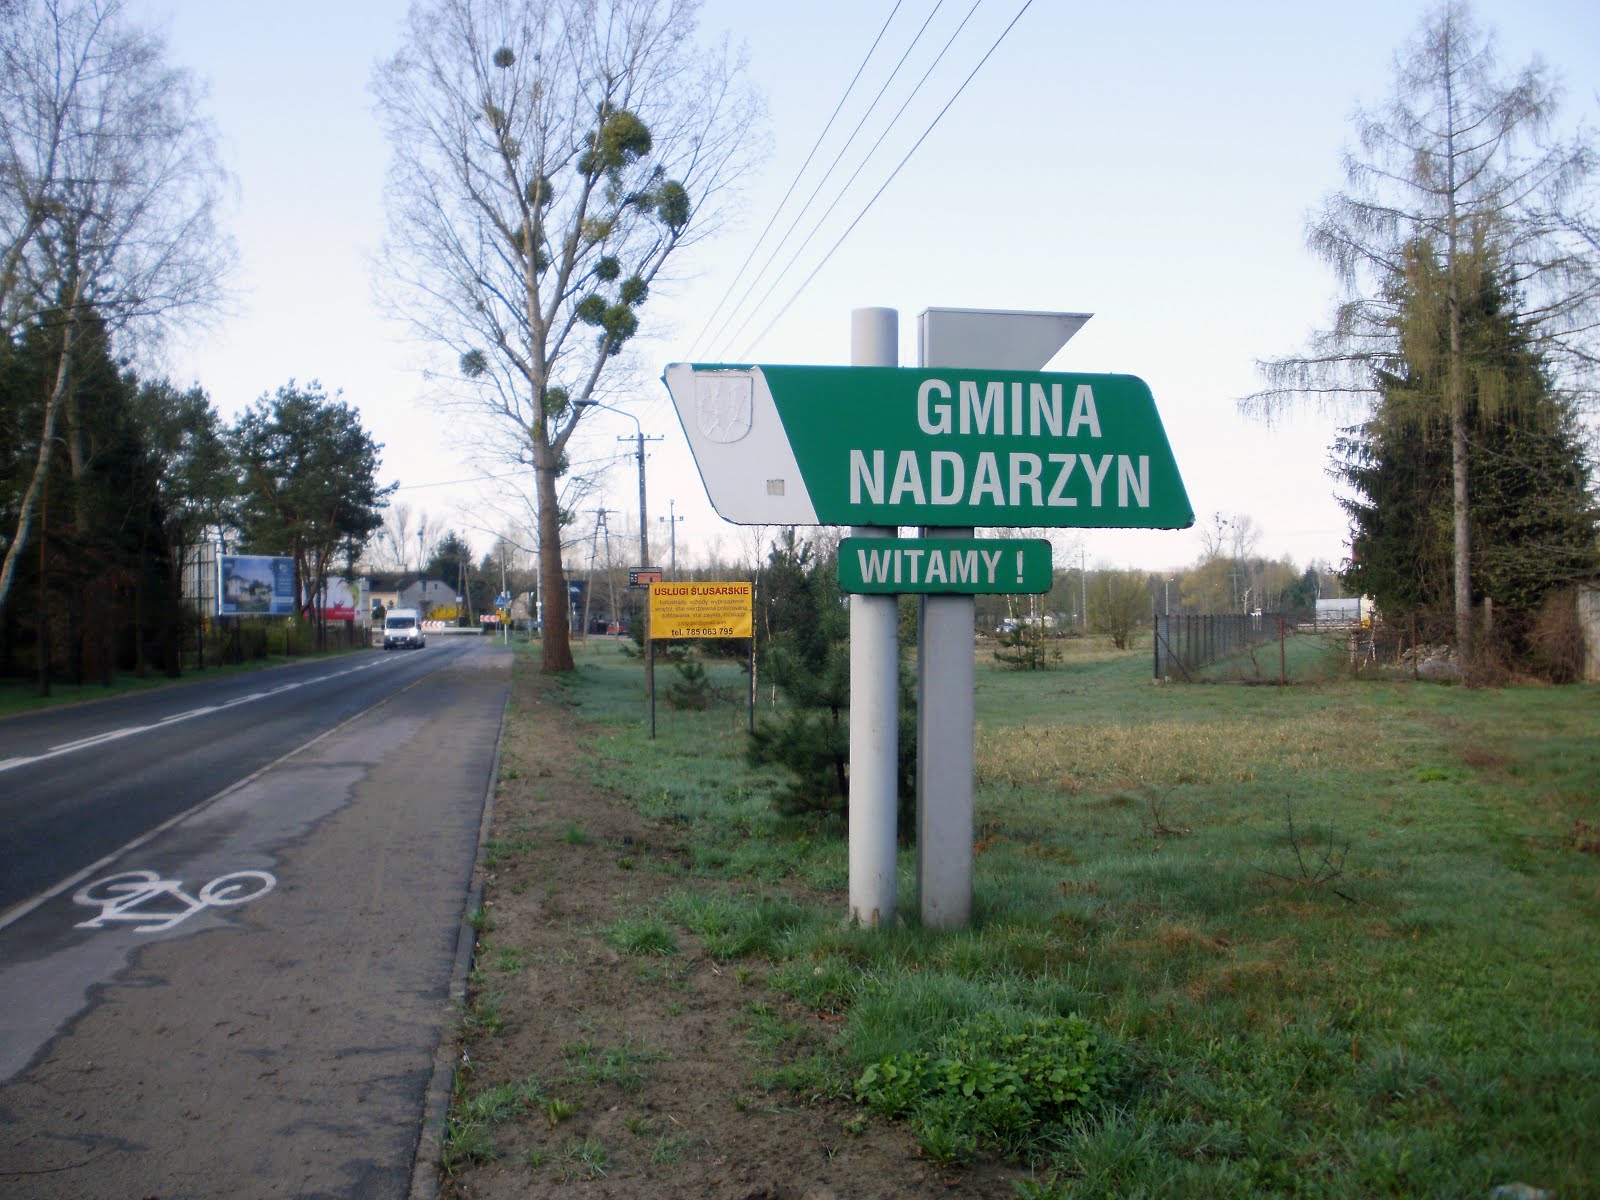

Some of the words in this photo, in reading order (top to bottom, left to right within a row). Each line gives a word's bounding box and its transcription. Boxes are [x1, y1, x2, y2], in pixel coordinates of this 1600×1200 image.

[917, 378, 1102, 439] GMINA
[849, 448, 1150, 509] NADARZYN
[857, 548, 1002, 585] WITAMY
[1015, 549, 1024, 584] !
[654, 587, 689, 596] USŁUGI
[691, 585, 749, 596] ŚLUSARSKIE
[671, 628, 683, 636] tel.
[686, 628, 701, 636] 785
[719, 627, 734, 635] 795
